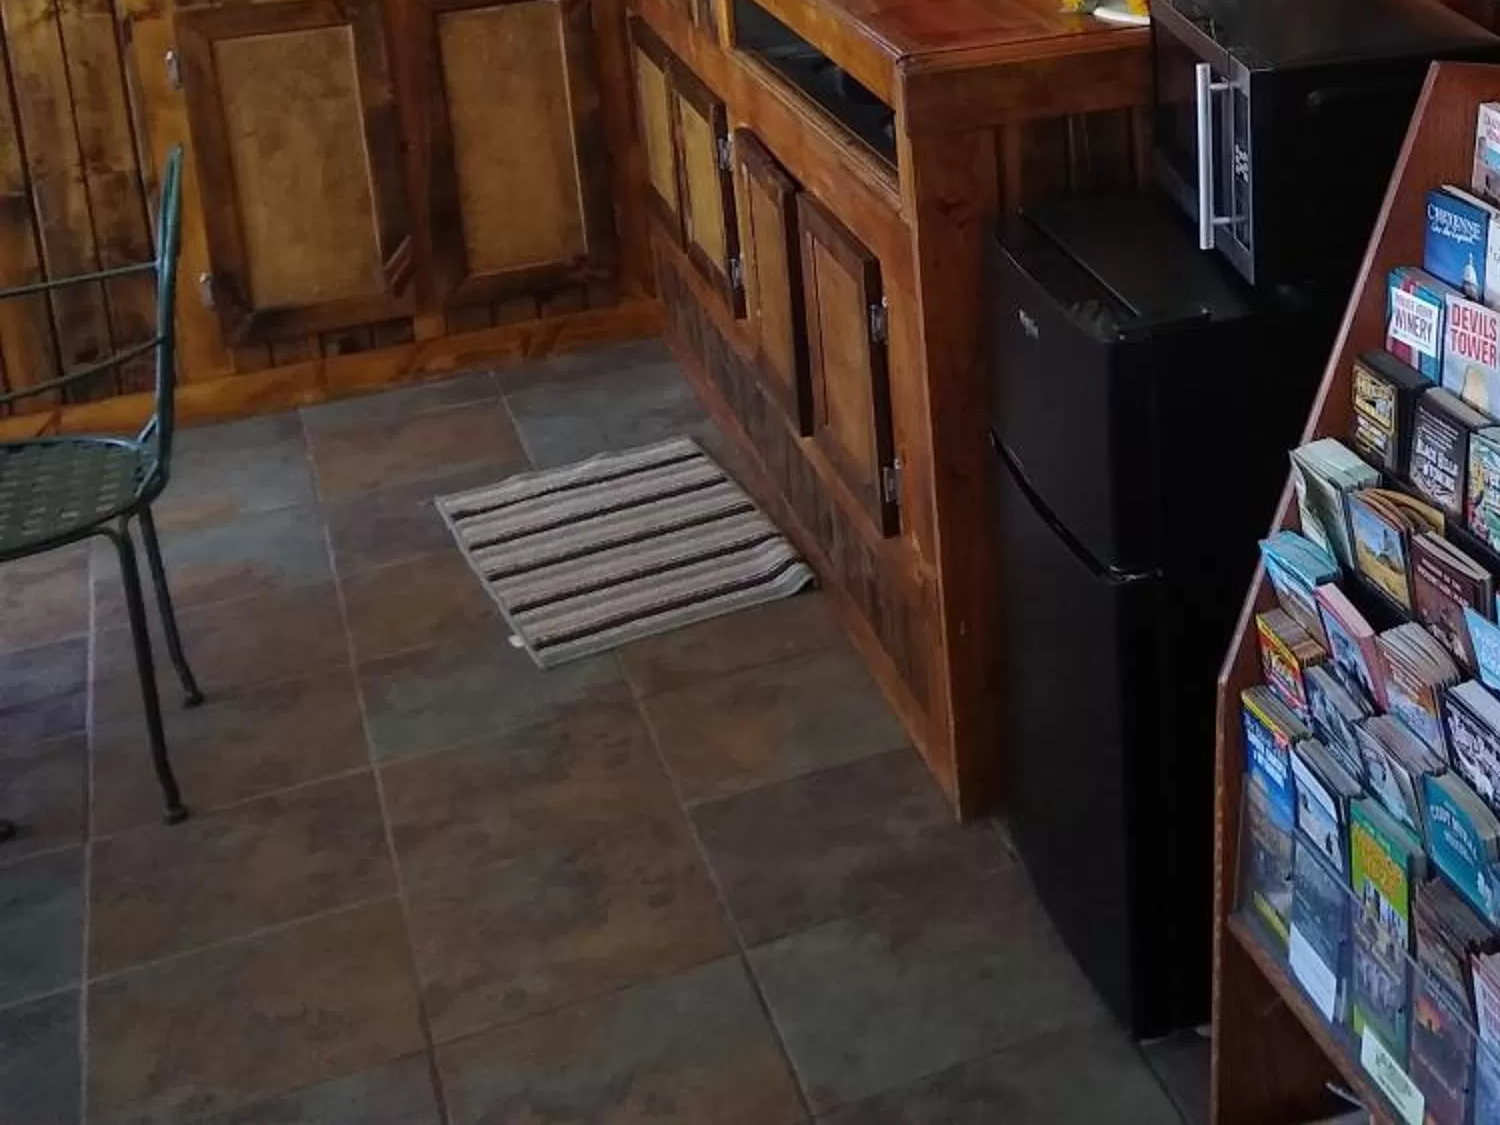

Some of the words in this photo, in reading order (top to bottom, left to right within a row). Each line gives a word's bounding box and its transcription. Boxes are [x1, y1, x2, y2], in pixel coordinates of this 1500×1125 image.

[1428, 203, 1481, 241] CHEYENNE
[1395, 306, 1433, 344] WINERY
[1452, 303, 1497, 342] DEVILS
[1450, 328, 1497, 370] TOWER
